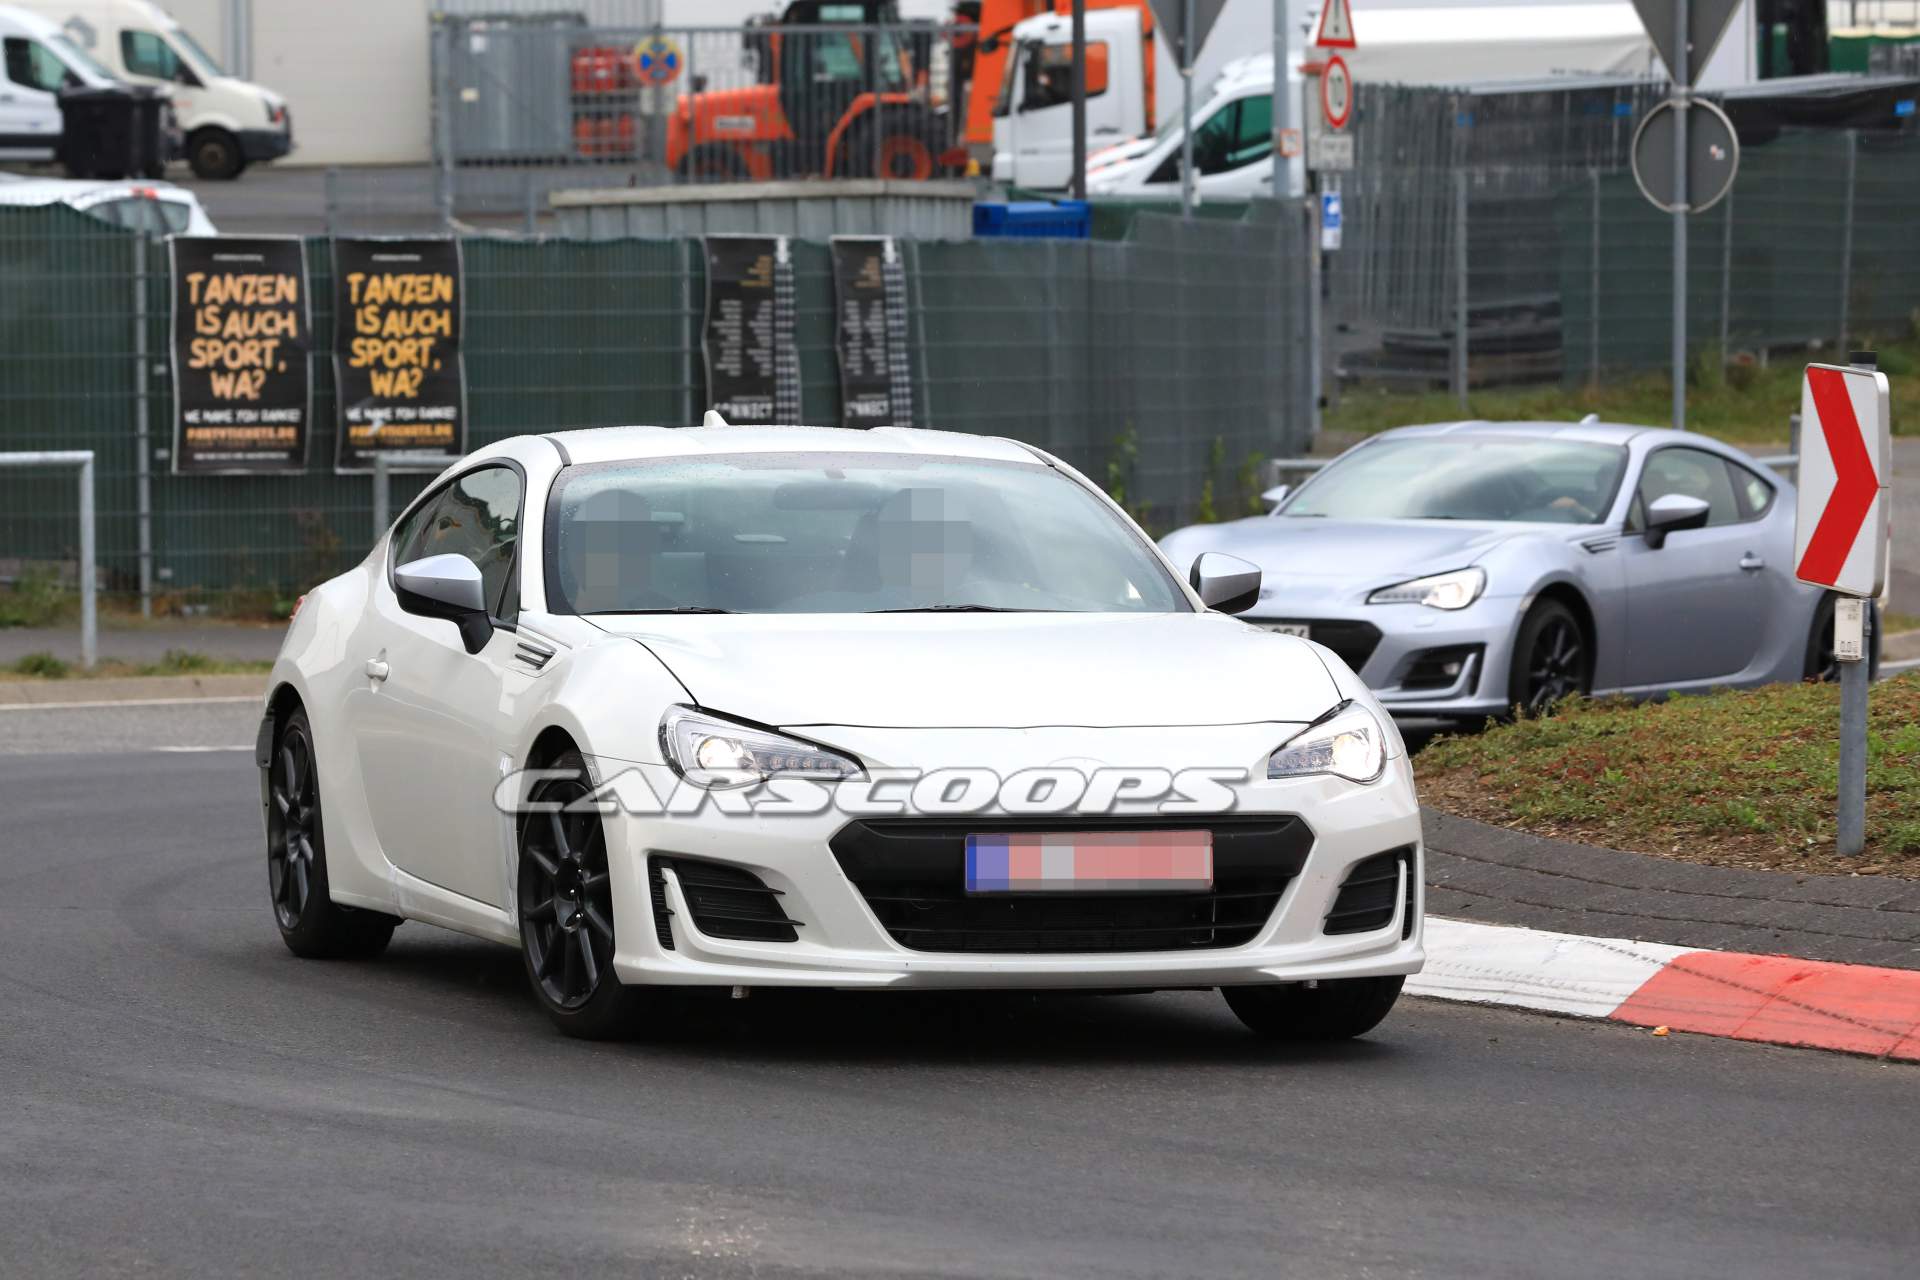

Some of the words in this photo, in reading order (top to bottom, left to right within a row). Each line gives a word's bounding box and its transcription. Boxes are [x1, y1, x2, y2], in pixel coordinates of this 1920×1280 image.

[187, 272, 297, 304] TANZEN
[347, 272, 452, 304] TANZEN
[196, 305, 221, 335] IS
[223, 311, 297, 339] AUCH
[356, 305, 380, 334] IS
[382, 310, 451, 338] AUCH
[211, 368, 266, 400] WA?
[370, 368, 424, 398] WA?
